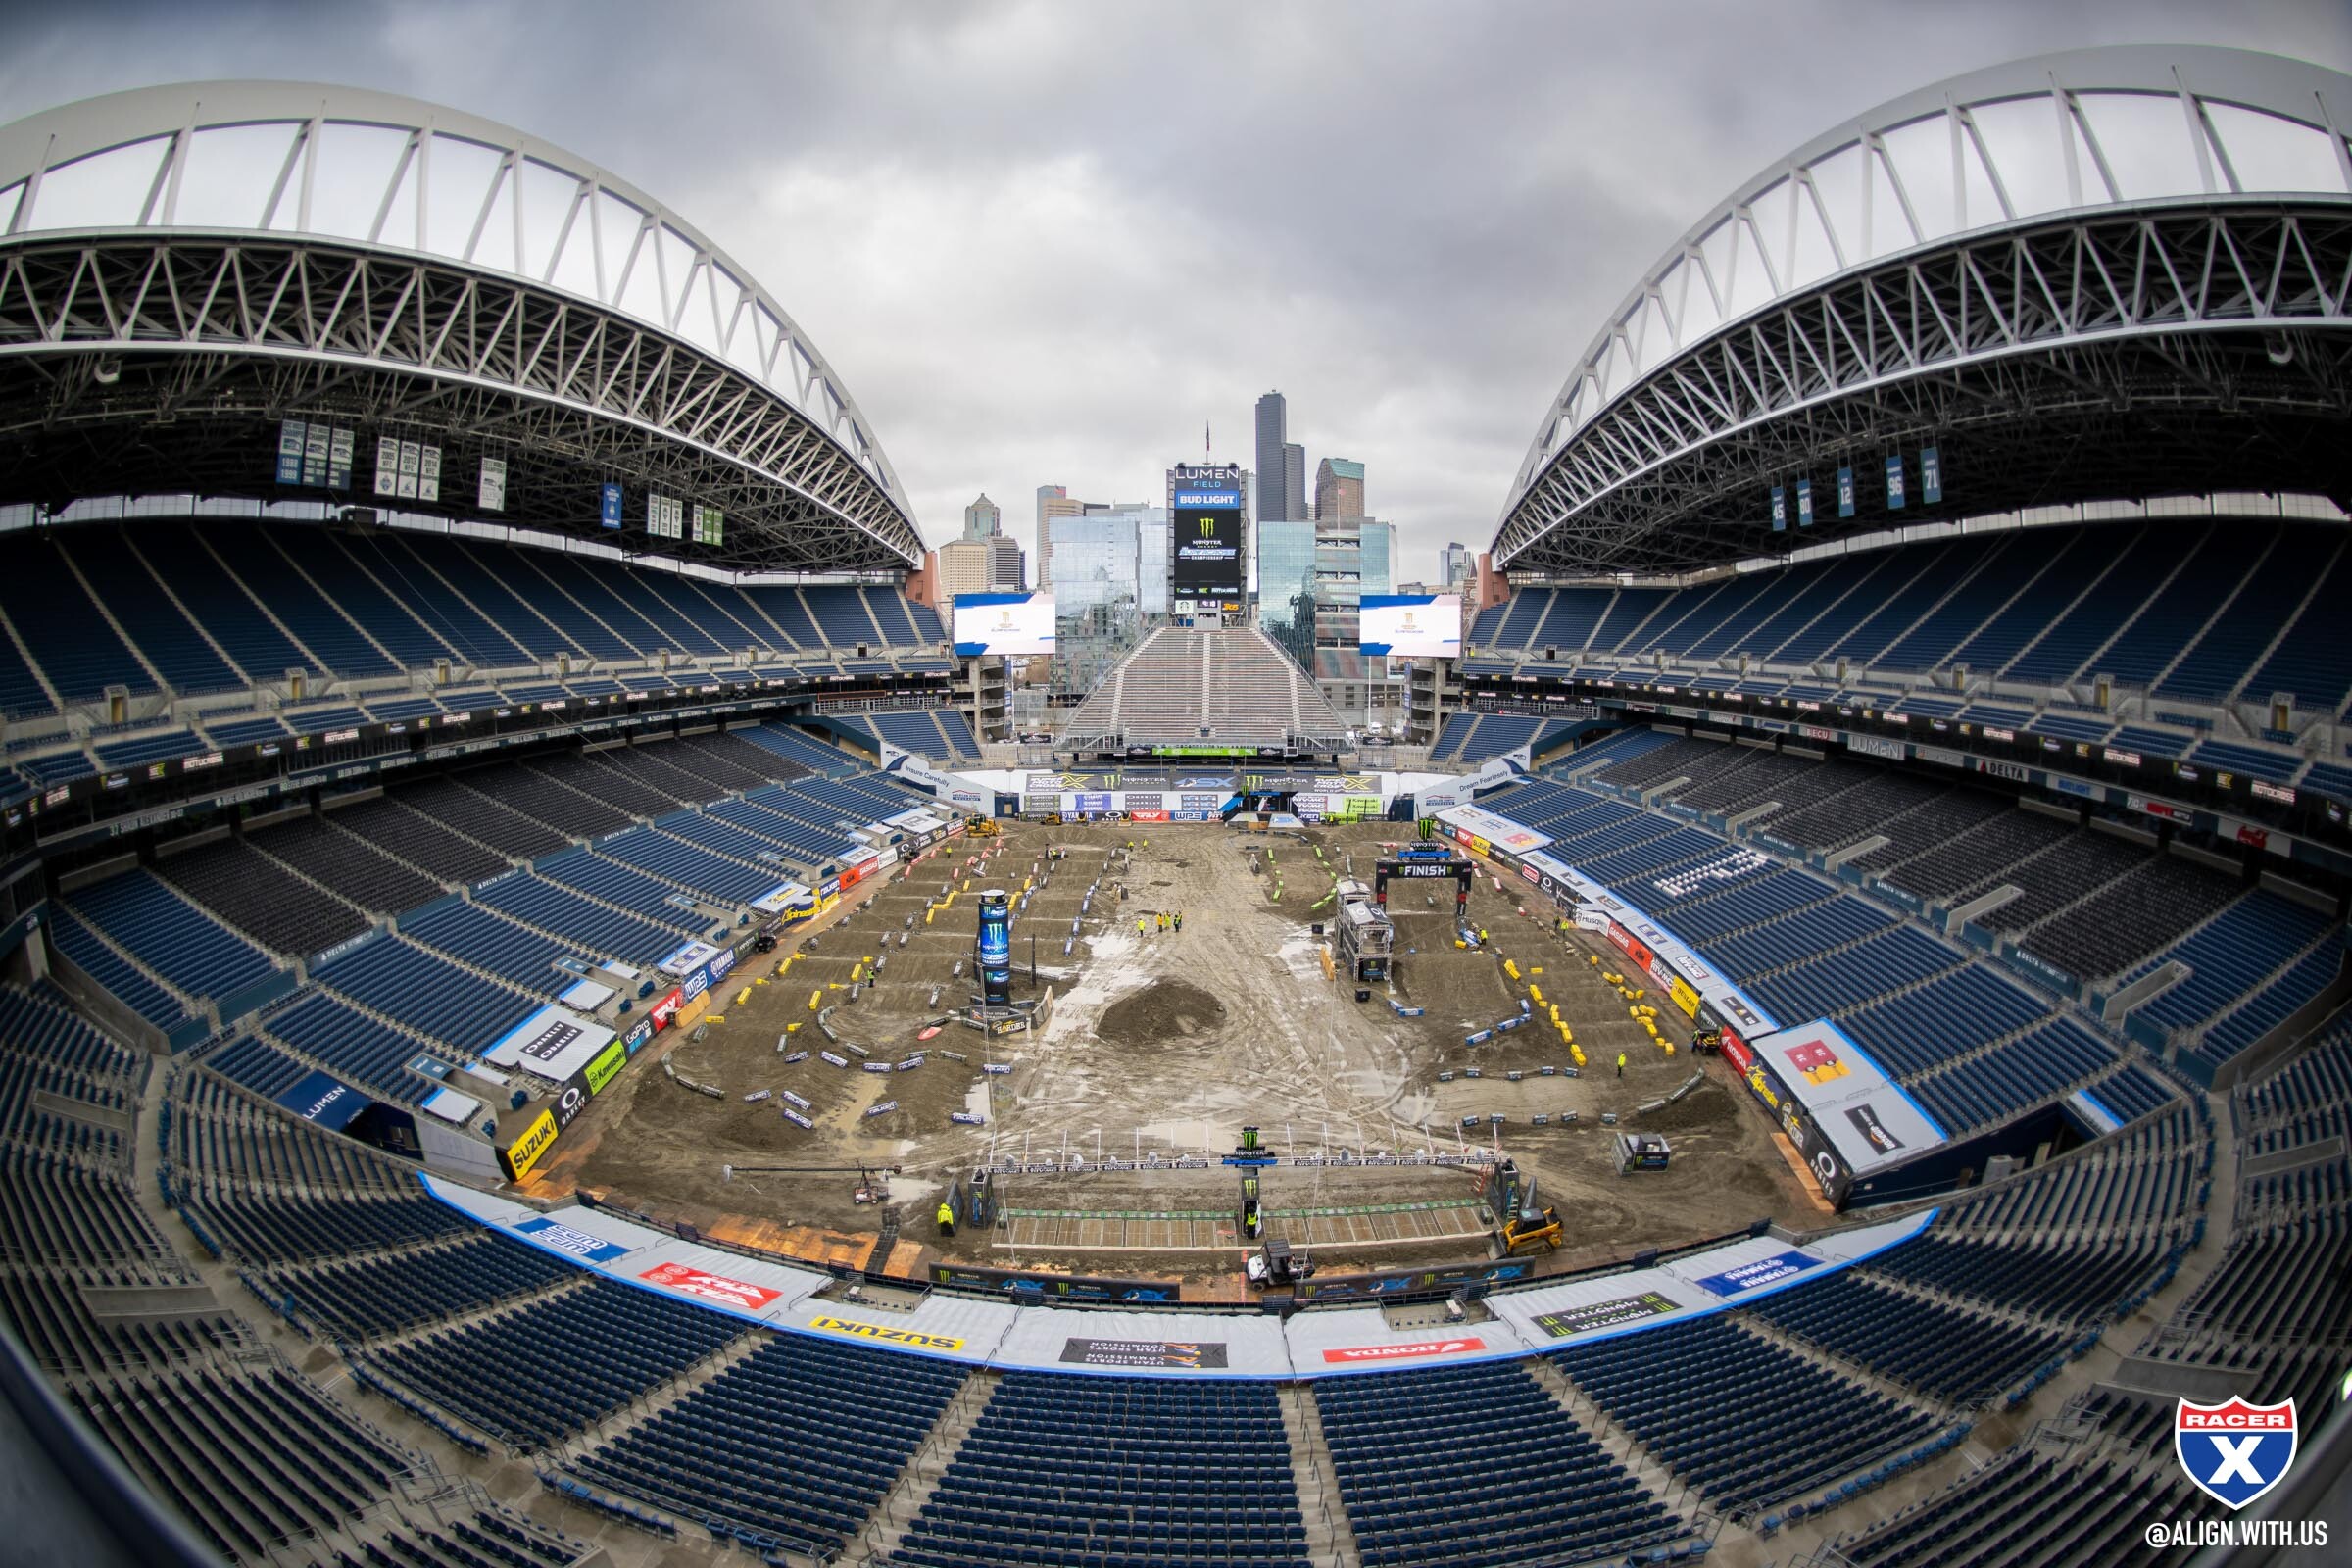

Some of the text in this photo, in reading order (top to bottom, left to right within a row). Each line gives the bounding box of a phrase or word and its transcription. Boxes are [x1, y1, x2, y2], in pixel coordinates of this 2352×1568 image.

[1176, 469, 1239, 479] LUMEN
[1924, 468, 1938, 490] 71
[1840, 486, 1851, 505] 12
[1887, 476, 1902, 496] 96
[1773, 504, 1784, 520] 45
[1806, 728, 1829, 739] BECU
[1849, 735, 1899, 759] LUMEN
[905, 764, 950, 788] Insure Carefully
[1459, 770, 1508, 792] Dream Fearlessly
[1989, 763, 2024, 780] DELTA
[1174, 812, 1202, 821] WPS
[1404, 865, 1446, 876] FINISH
[820, 878, 840, 896] FALKEN
[1608, 927, 1630, 948] GASGAS
[715, 949, 735, 971] YAMAHA
[685, 971, 708, 999] WPS
[1677, 988, 1696, 1007] DUNLOP
[537, 1022, 564, 1046] OAKLEY
[550, 1029, 578, 1054] OAKLEY
[626, 1020, 650, 1044] GoPro
[597, 1050, 625, 1081] Kawasaki
[1727, 1041, 1747, 1070] HONDA
[303, 1086, 346, 1120] LUMEN
[561, 1095, 586, 1125] OAKLEY
[514, 1119, 555, 1169] SUZUKI
[1810, 1159, 1834, 1196] OAKLEY
[530, 1230, 591, 1254] WPS
[546, 1224, 609, 1250] WPS
[1724, 1263, 1770, 1280] YAMAHA
[1740, 1269, 1787, 1288] YAMAHA
[672, 1284, 751, 1307] FLY
[687, 1276, 764, 1299] FLY
[1562, 1300, 1640, 1320] MONSTER
[1576, 1308, 1653, 1330] MONSTER
[817, 1318, 956, 1348] SUZUKI
[1342, 1345, 1438, 1357] HONDA
